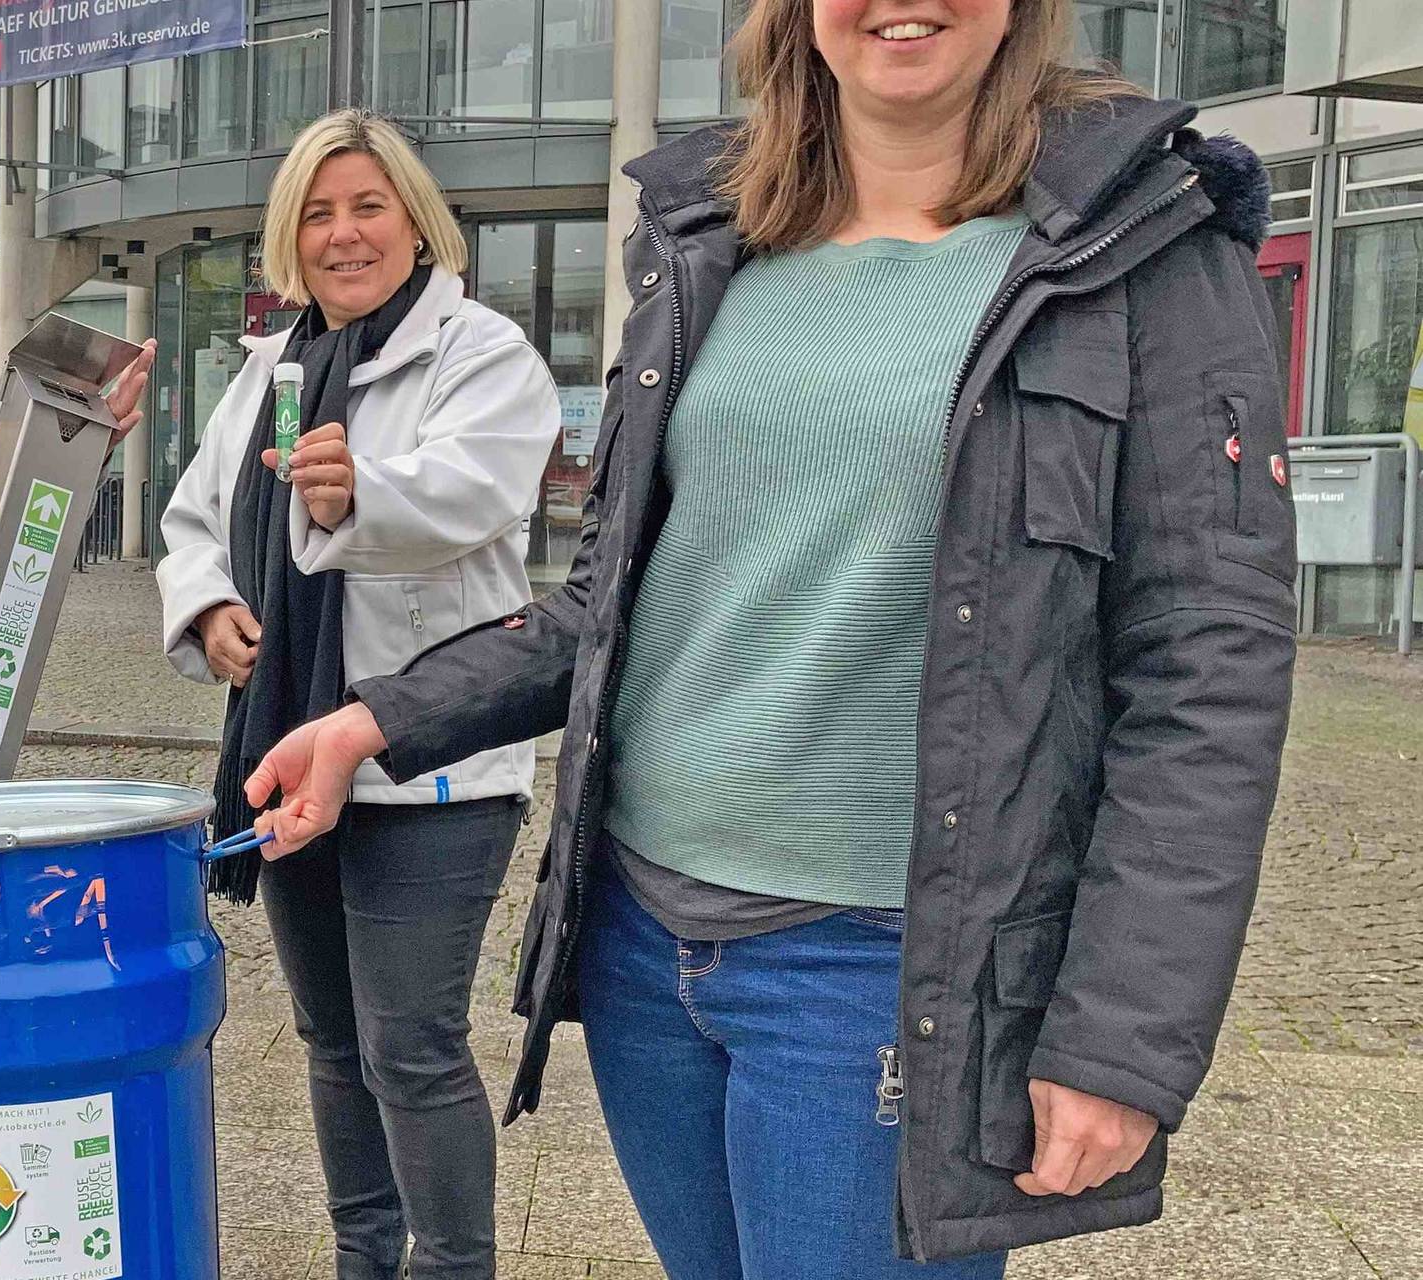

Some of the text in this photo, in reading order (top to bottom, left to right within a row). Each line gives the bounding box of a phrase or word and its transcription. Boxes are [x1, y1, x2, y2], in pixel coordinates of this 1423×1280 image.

[29, 2, 90, 30] KULTUR
[19, 17, 210, 65] TICKETS: www.3k.reservix.de
[3, 600, 25, 645] REDUCE
[14, 600, 36, 648] RECYCLE
[27, 1108, 44, 1116] MIT
[26, 1172, 49, 1180] system
[88, 1166, 102, 1219] REDUCE
[100, 1160, 114, 1217] RECYCLE
[77, 1177, 90, 1221] REUSE
[23, 1256, 62, 1265] Verwertung
